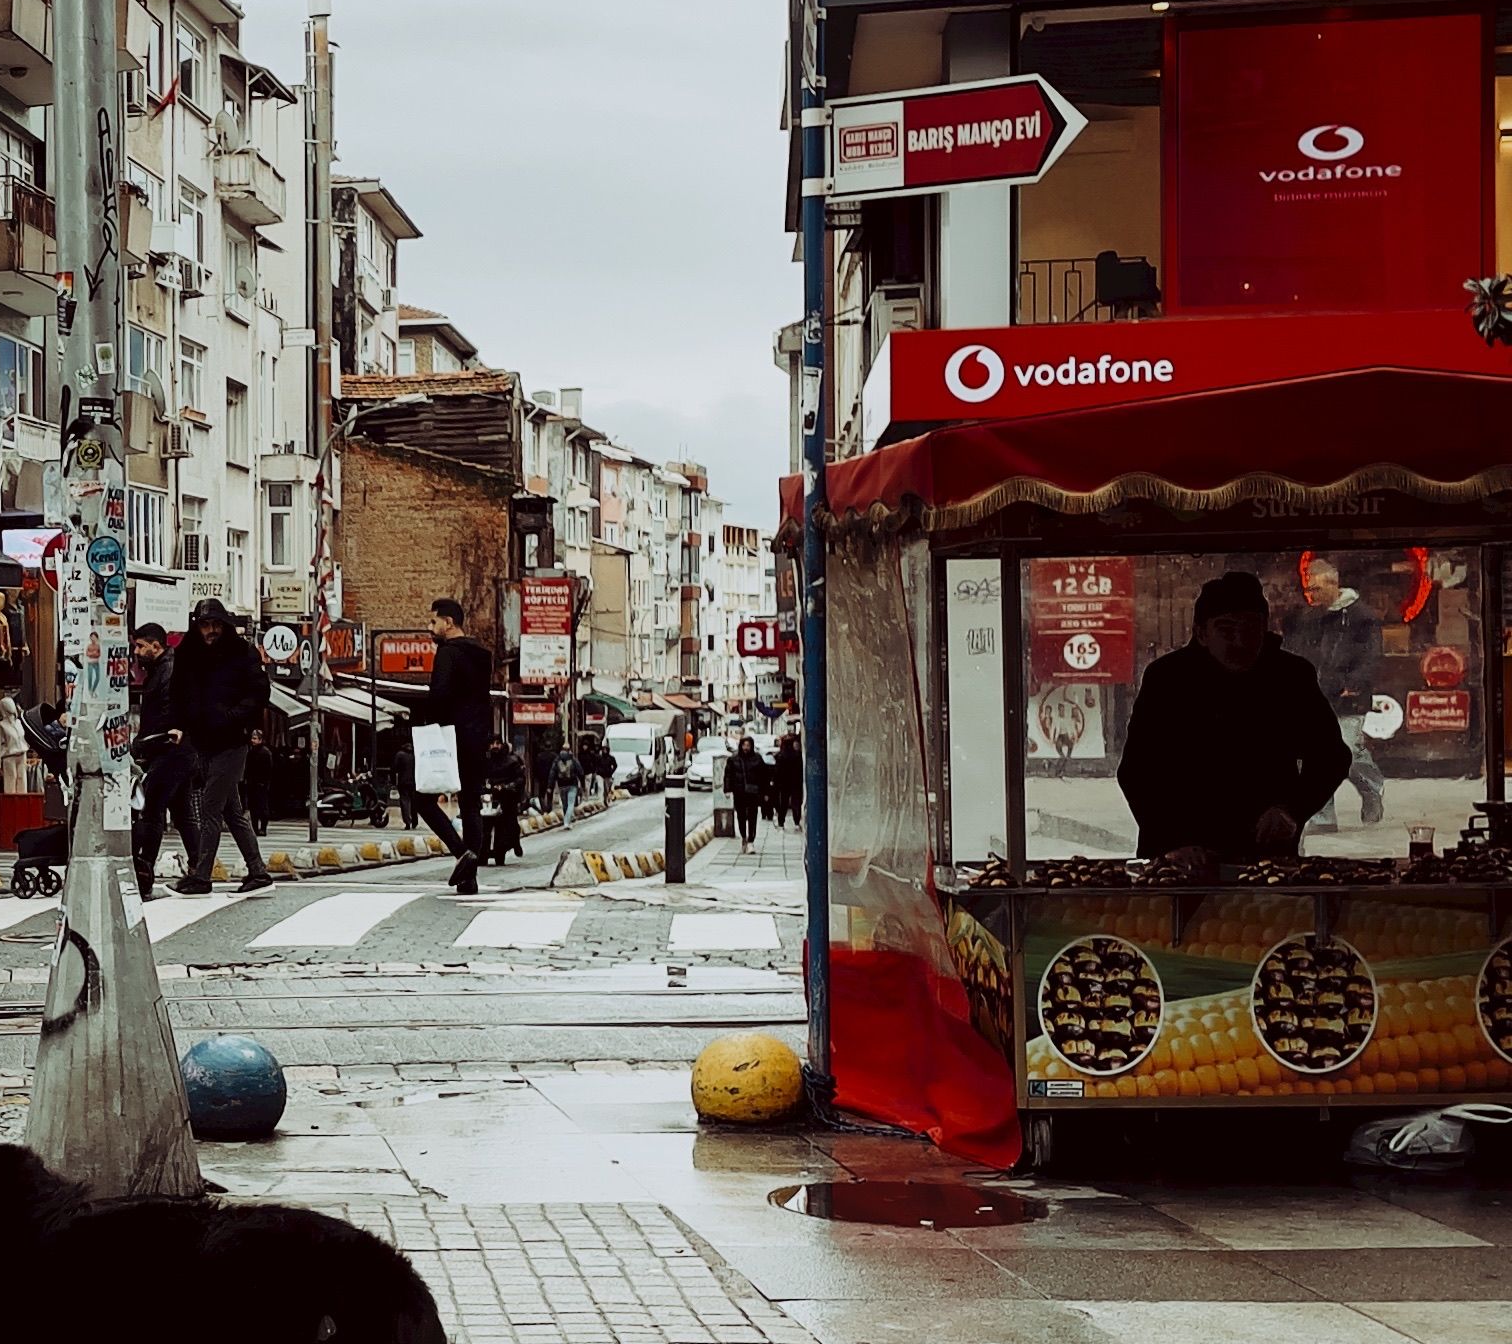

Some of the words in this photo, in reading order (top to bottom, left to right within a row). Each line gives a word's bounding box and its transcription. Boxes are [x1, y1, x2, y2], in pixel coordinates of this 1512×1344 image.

[908, 125, 954, 154] BARIŞ
[957, 118, 1013, 148] MANÇO
[1015, 109, 1041, 141] EVİ
[1258, 163, 1403, 184] vodafone
[1013, 354, 1175, 388] vodafone
[191, 582, 223, 597] PROTEZ
[1052, 577, 1079, 595] 12
[1067, 641, 1098, 656] 165
